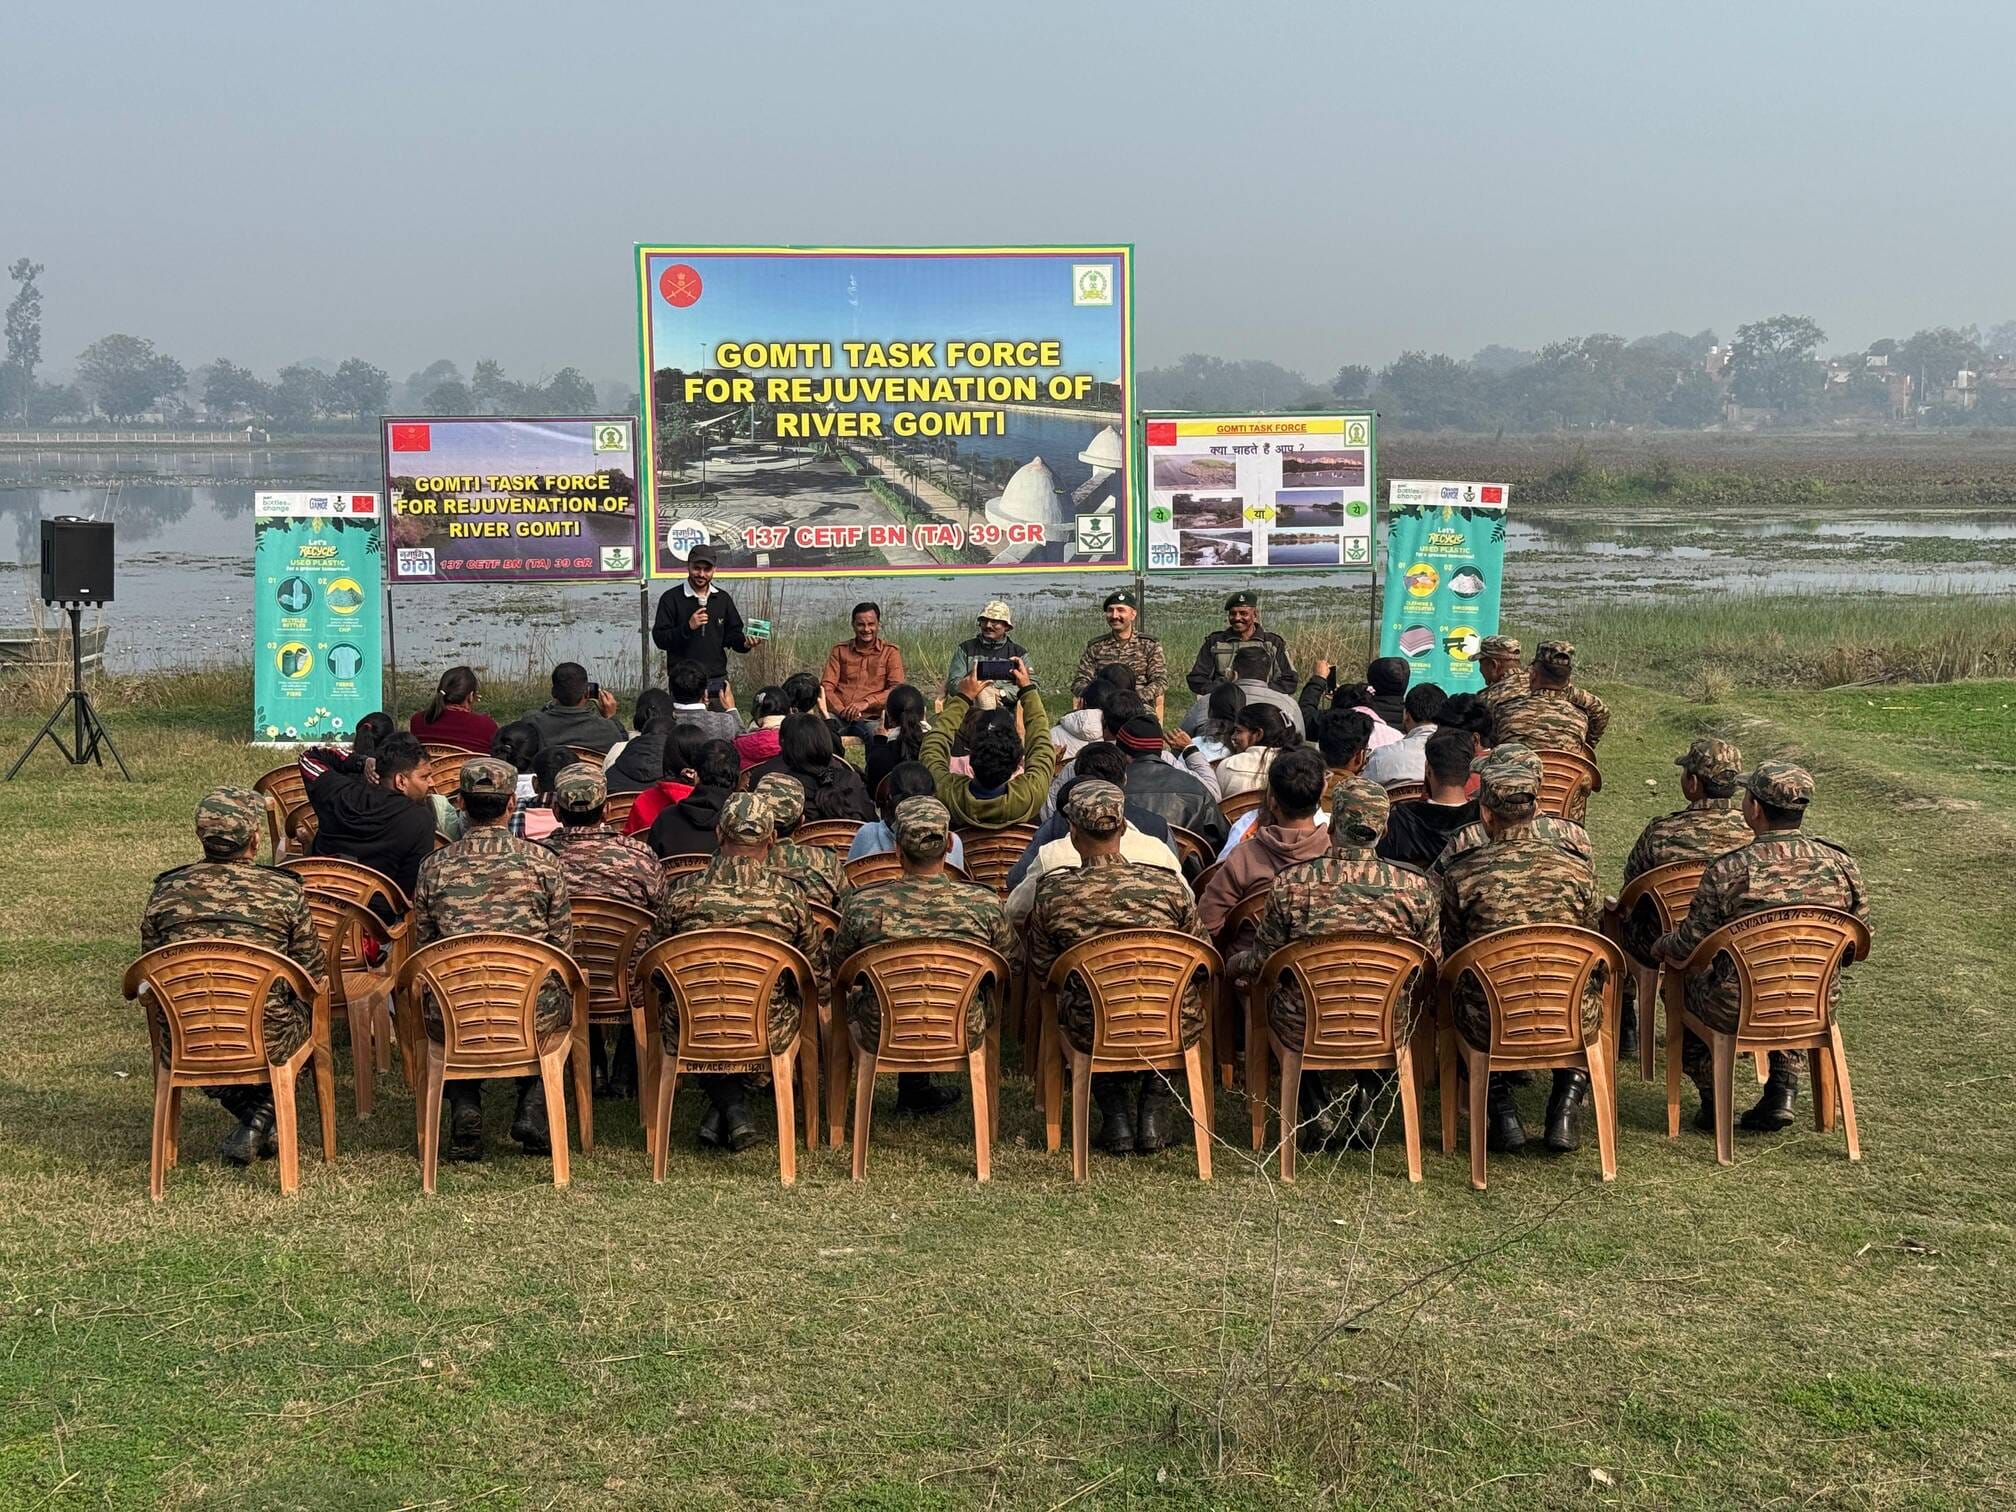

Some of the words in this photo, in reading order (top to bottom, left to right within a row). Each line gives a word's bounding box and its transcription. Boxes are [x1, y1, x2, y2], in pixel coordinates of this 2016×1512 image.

[716, 342, 832, 369] GOMTI
[843, 342, 936, 368] TASK
[946, 341, 1061, 367] FORCE
[685, 378, 756, 403] FOR
[768, 376, 1038, 403] REJUVENATION
[1048, 375, 1093, 400] OF
[776, 412, 883, 437] RIVER
[893, 411, 1006, 436] GOMTI
[1216, 424, 1247, 433] GOMTI
[1249, 423, 1273, 433] TASK
[1275, 422, 1307, 432] FORCE
[1209, 445, 1227, 455] क्या
[1232, 443, 1259, 455] चाहते
[1275, 444, 1294, 454] आप
[415, 476, 480, 492] GOMTI
[486, 475, 539, 491] TASK
[545, 475, 610, 490] FORCE
[398, 499, 437, 515] FOR
[443, 498, 597, 514] REJUVENATION
[603, 497, 629, 512] OF
[1253, 509, 1266, 520] या
[1352, 503, 1362, 515] ये
[1155, 509, 1166, 522] ये
[450, 521, 510, 538] RIVER
[516, 521, 581, 537] GOMTI
[743, 527, 789, 548] 137
[796, 527, 861, 548] CETF
[870, 526, 905, 545] BN
[913, 525, 963, 550] (TA)
[970, 525, 1000, 544] 39
[1008, 524, 1045, 543] GR
[440, 559, 464, 570] 137
[466, 559, 500, 569] CETF
[503, 558, 522, 569] BN
[525, 558, 551, 570] (TA)
[573, 557, 593, 568] GR
